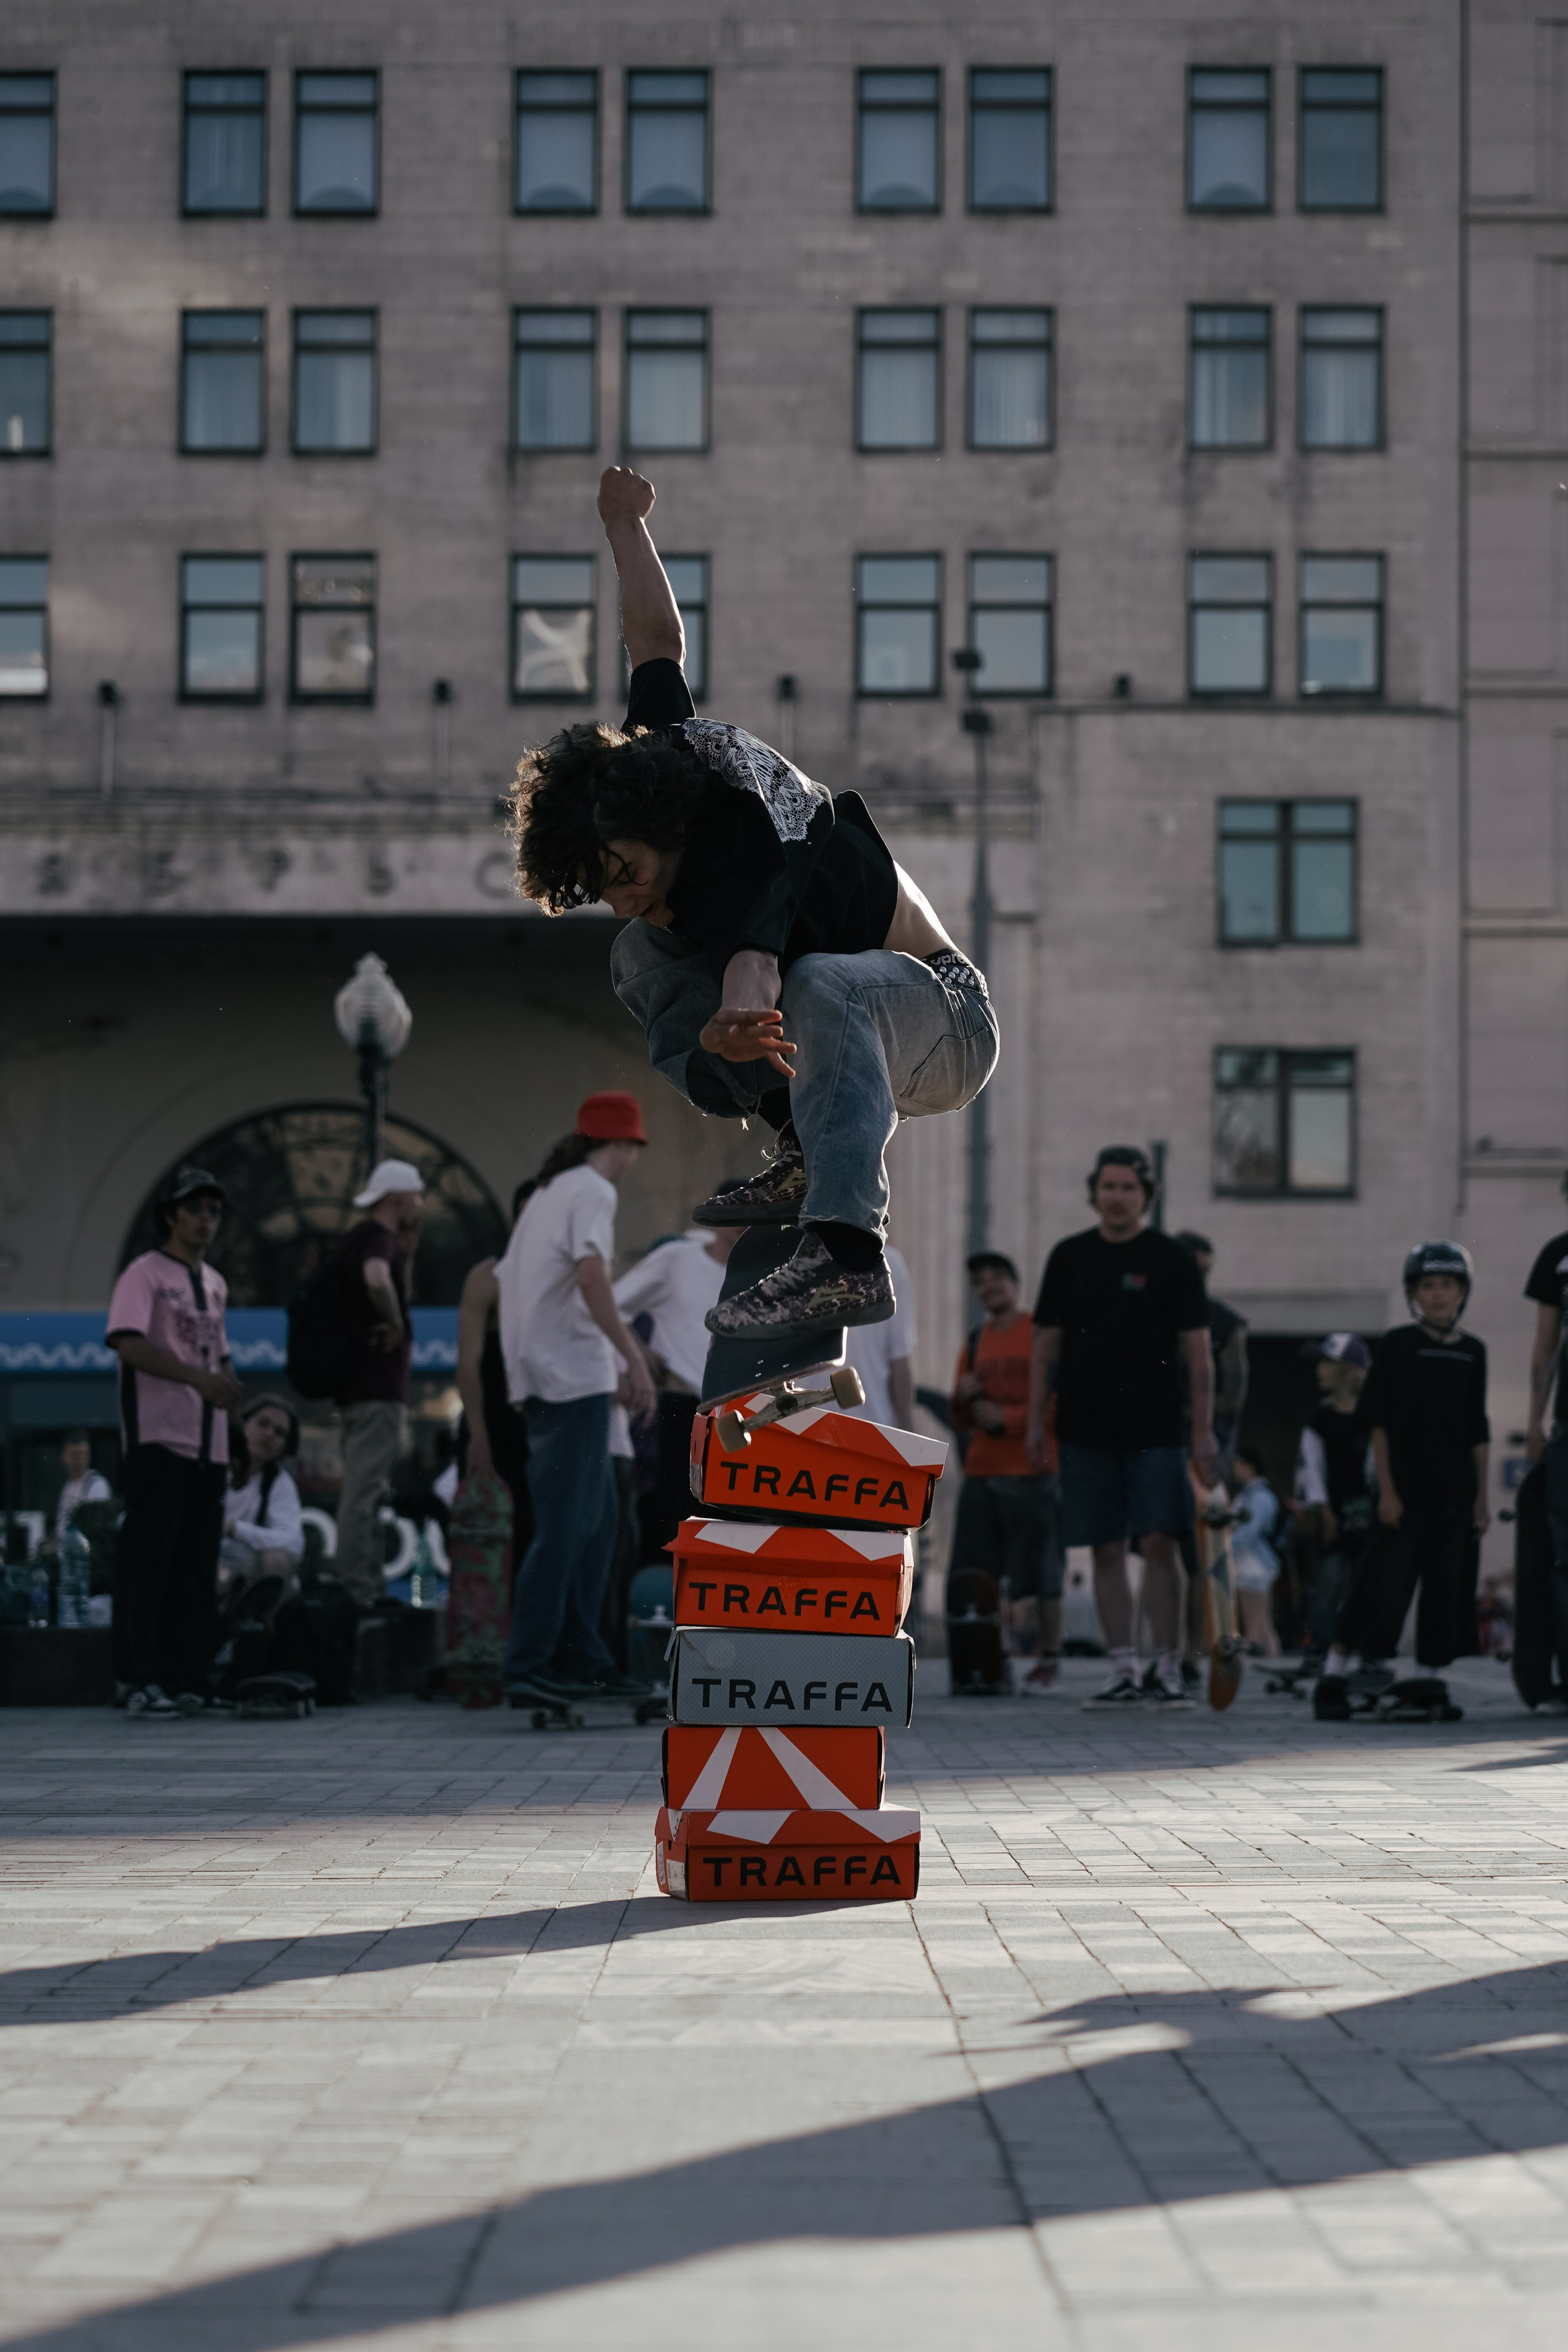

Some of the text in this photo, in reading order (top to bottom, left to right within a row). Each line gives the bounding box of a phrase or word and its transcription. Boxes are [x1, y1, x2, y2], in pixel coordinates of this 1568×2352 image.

[721, 1461, 909, 1510] TRAFFA
[689, 1582, 880, 1621] TRAFFA
[692, 1678, 892, 1713] TRAFFA
[703, 1856, 901, 1887] TRAFFA
